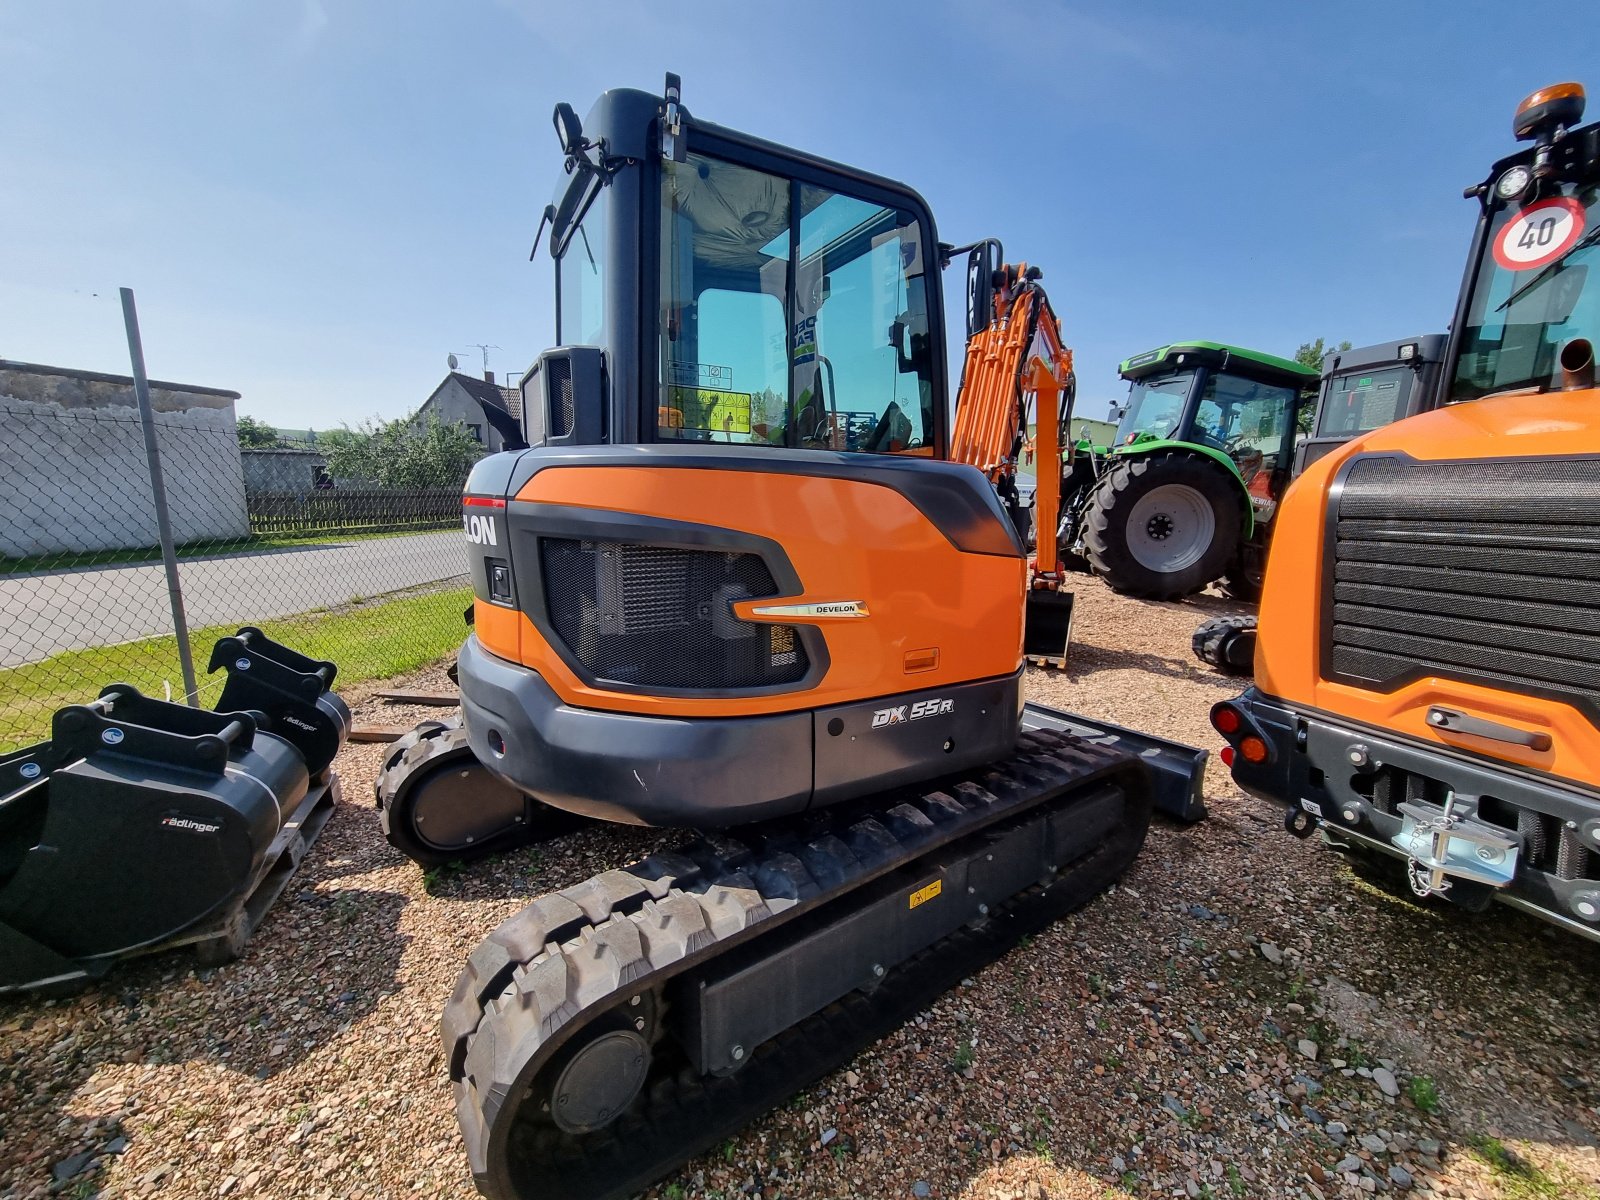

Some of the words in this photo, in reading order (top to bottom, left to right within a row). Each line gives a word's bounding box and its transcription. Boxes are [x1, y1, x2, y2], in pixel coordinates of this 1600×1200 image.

[1517, 217, 1556, 249] 40
[816, 605, 856, 613] DEVELON
[872, 705, 908, 729] DX
[161, 817, 220, 832] rädlinger
